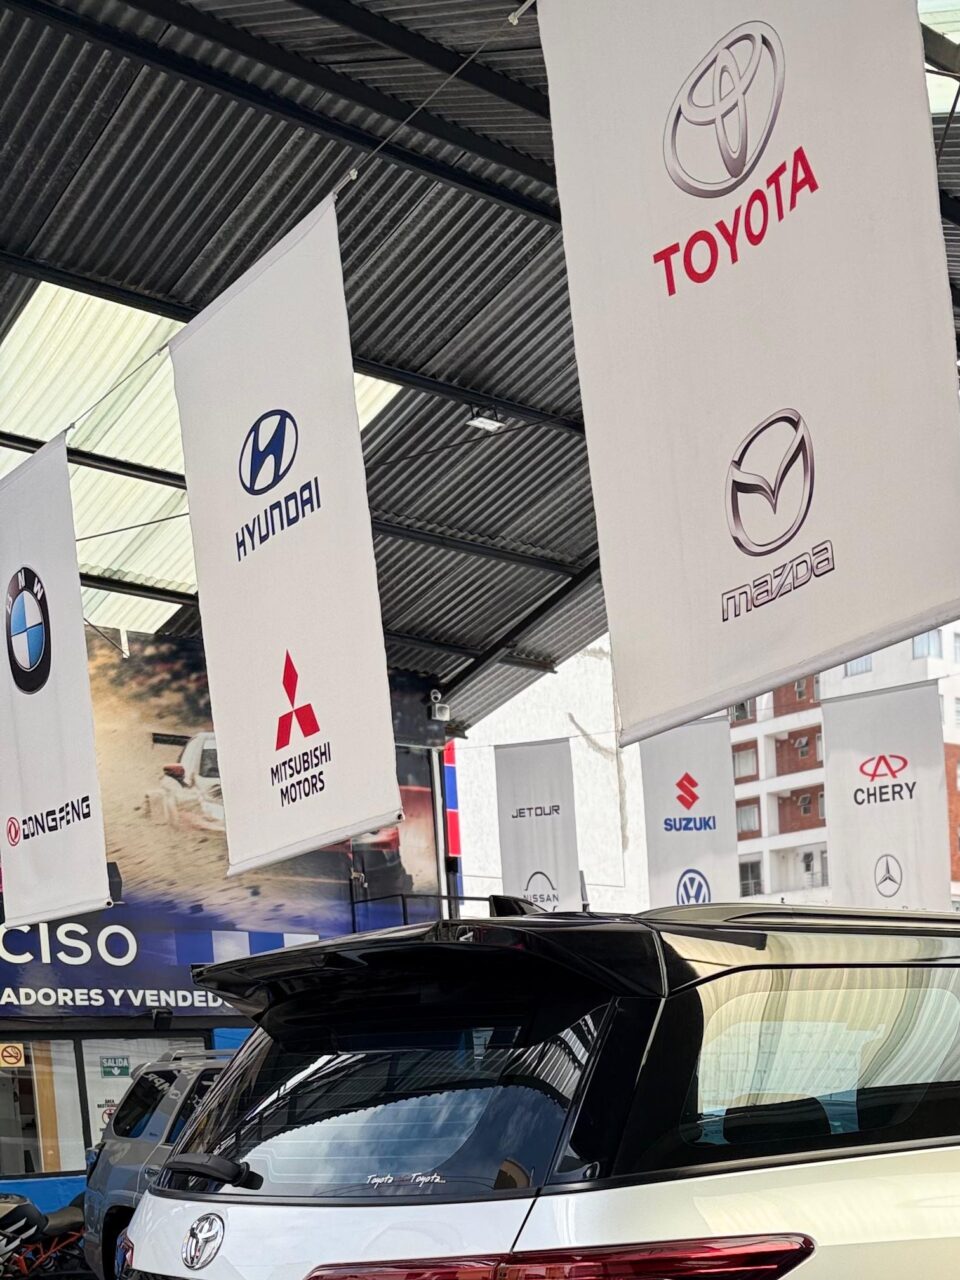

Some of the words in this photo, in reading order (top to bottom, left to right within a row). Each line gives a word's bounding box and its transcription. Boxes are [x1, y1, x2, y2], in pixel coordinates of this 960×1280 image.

[653, 146, 819, 297] TOYOTA
[235, 476, 321, 562] HYUNDAI
[721, 539, 835, 623] mazda
[270, 741, 332, 787] MITSUBISHI
[280, 770, 325, 807] MOTORS
[853, 781, 917, 806] CHERY
[22, 795, 91, 840] DONGFENG
[511, 805, 560, 819] JETOUR
[663, 815, 717, 832] SUZUKI
[523, 894, 560, 903] NISSAN
[0, 922, 137, 966] CISO
[0, 987, 103, 1006] ADORES
[107, 988, 126, 1006] Y
[103, 1058, 129, 1067] SALIDA
[366, 1174, 394, 1189] Toyota
